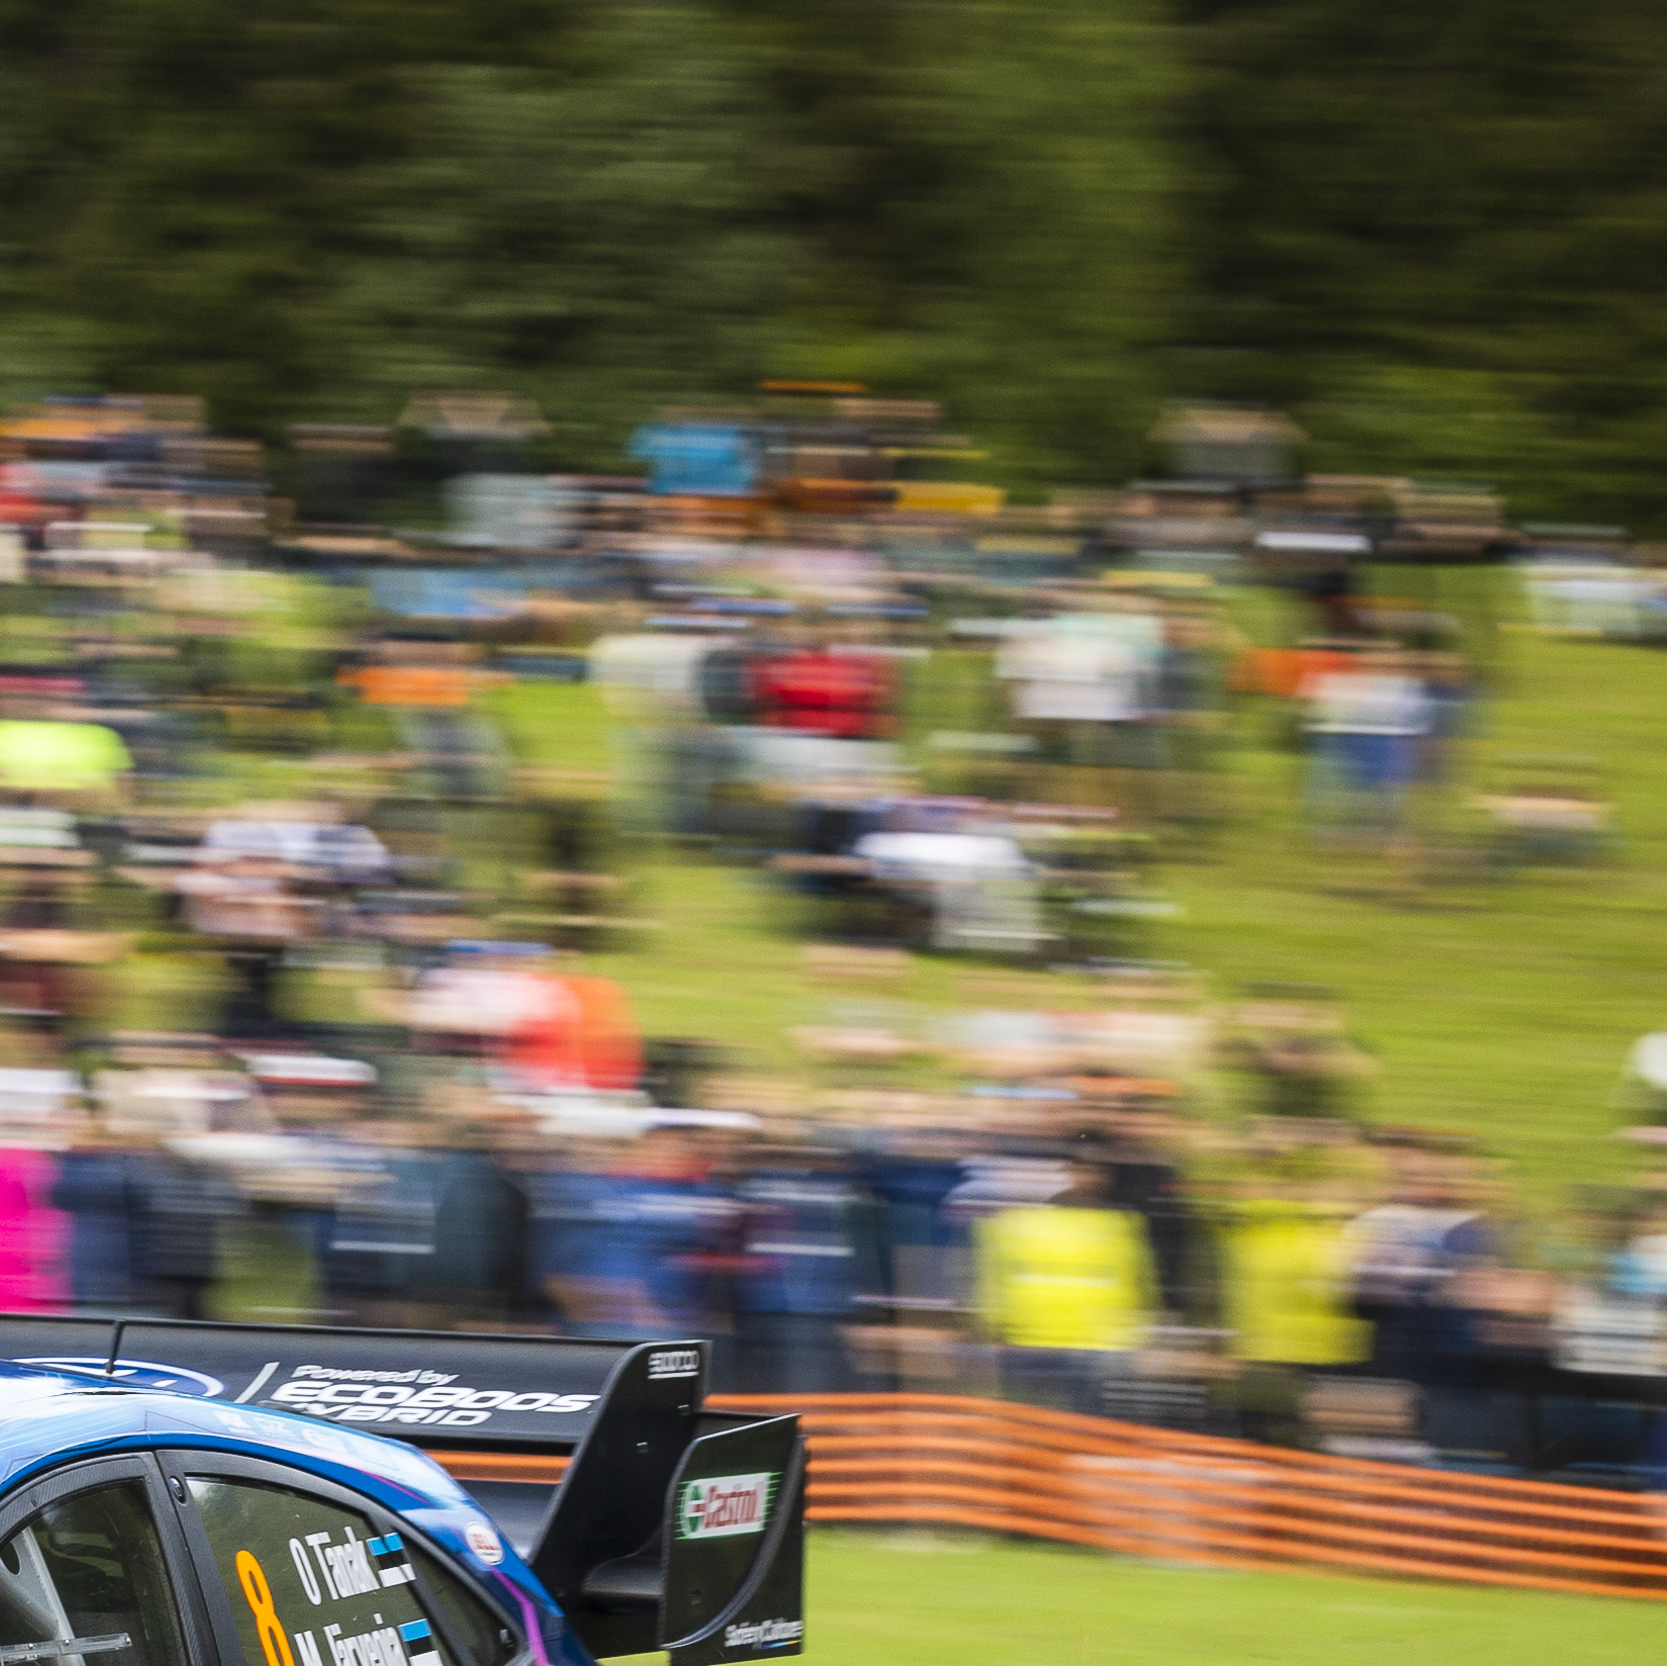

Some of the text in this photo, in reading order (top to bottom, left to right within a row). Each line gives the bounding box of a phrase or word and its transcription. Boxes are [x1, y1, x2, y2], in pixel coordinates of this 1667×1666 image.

[291, 1365, 460, 1386] Powered by
[271, 1380, 603, 1413] ECOBOOS
[289, 1537, 322, 1605] O
